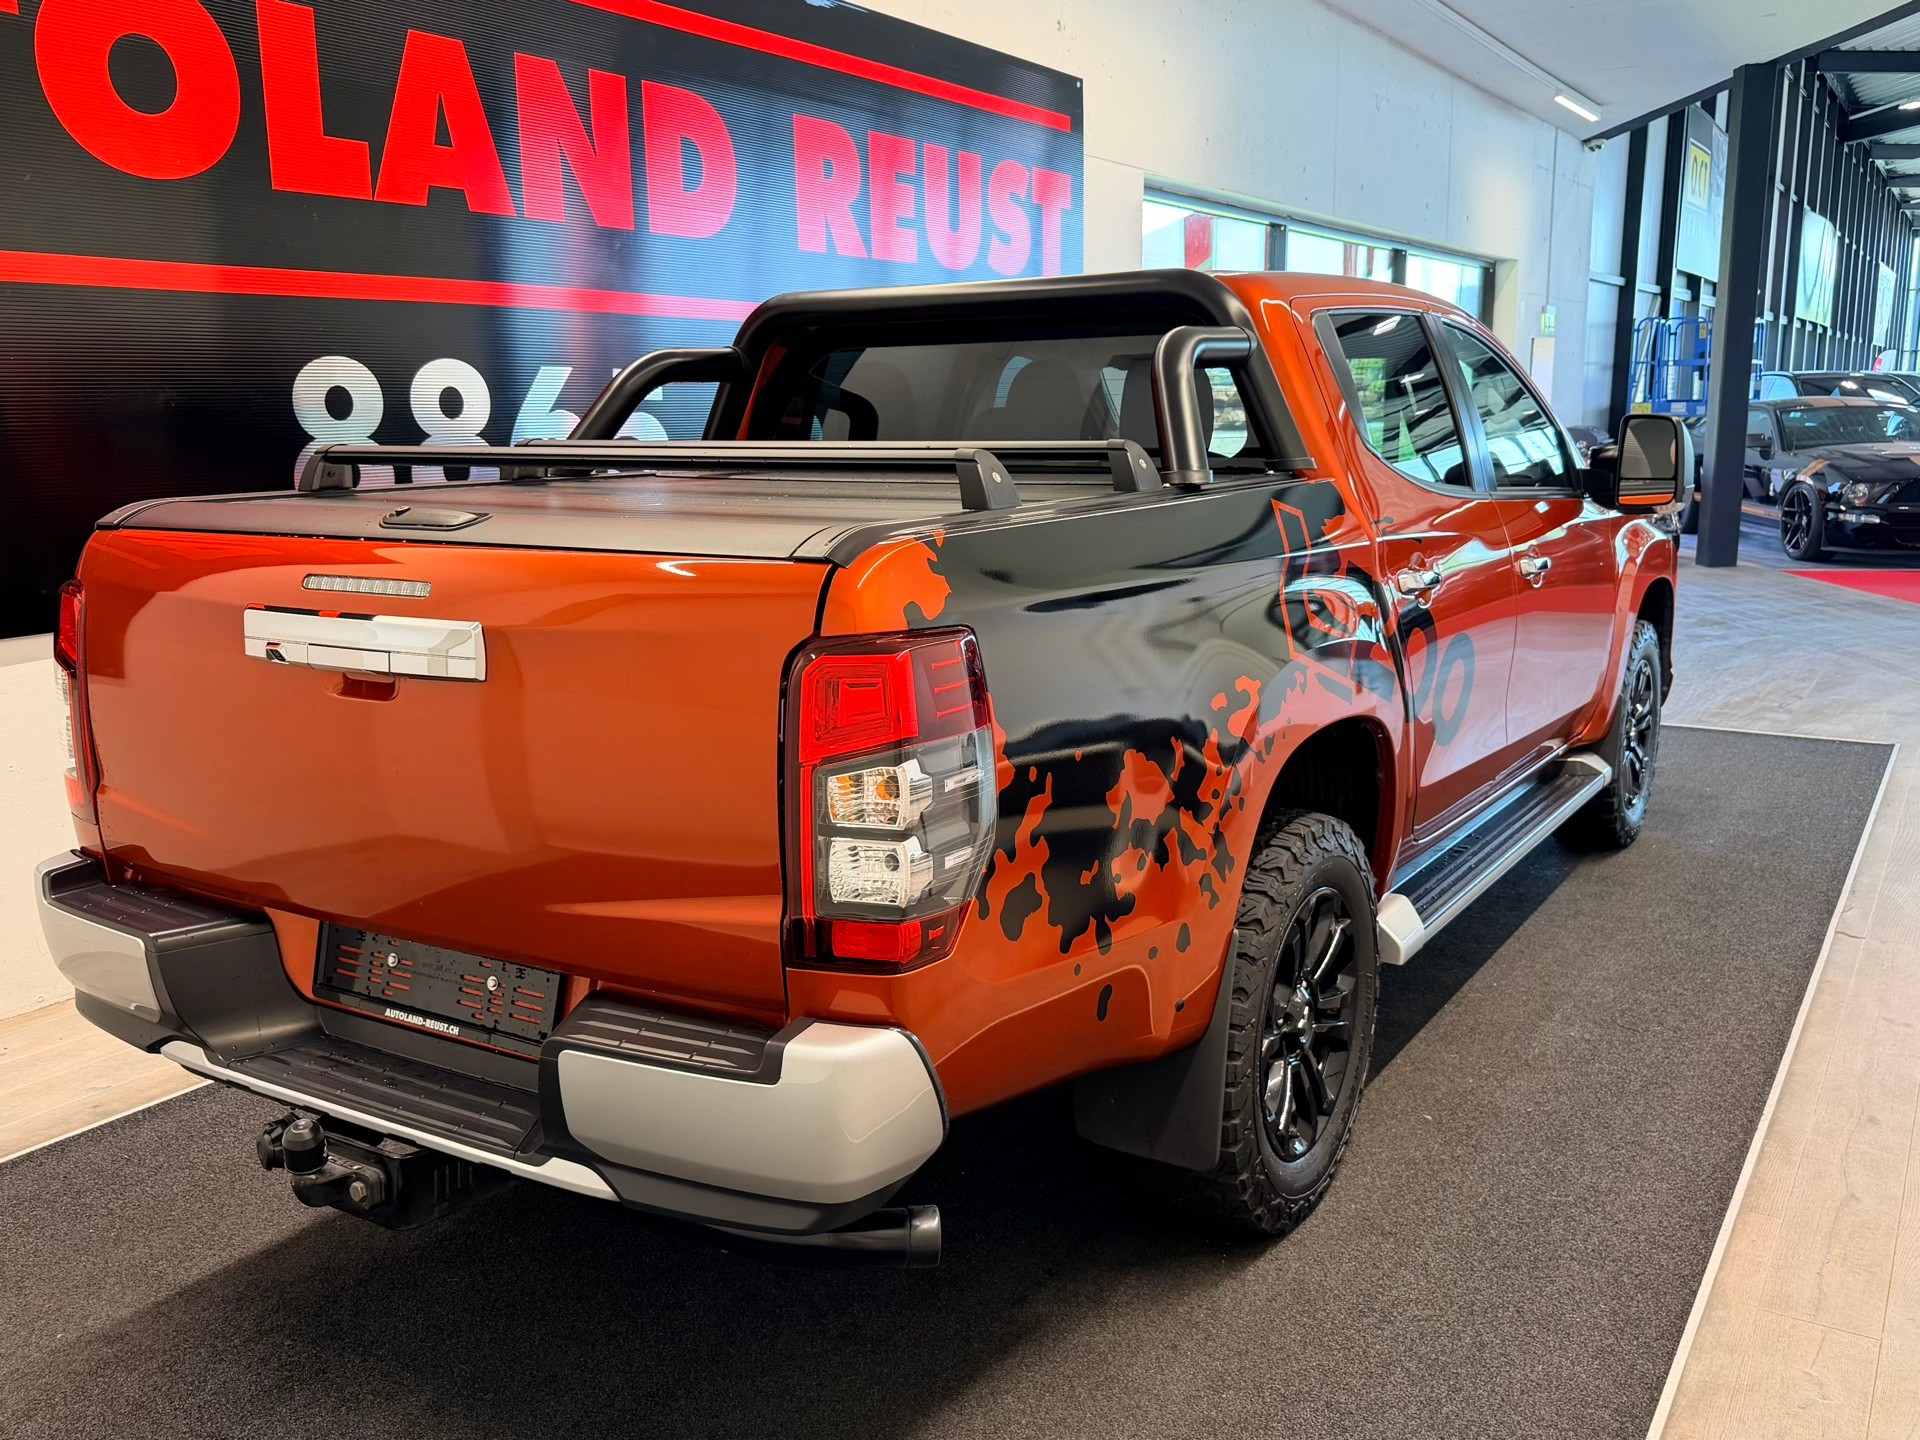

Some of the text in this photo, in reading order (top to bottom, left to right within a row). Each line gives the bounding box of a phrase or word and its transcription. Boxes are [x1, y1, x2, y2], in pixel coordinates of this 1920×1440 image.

[0, 0, 1072, 277] OLAND REUST
[384, 1008, 460, 1035] AUTOLAND-REUST.CH
